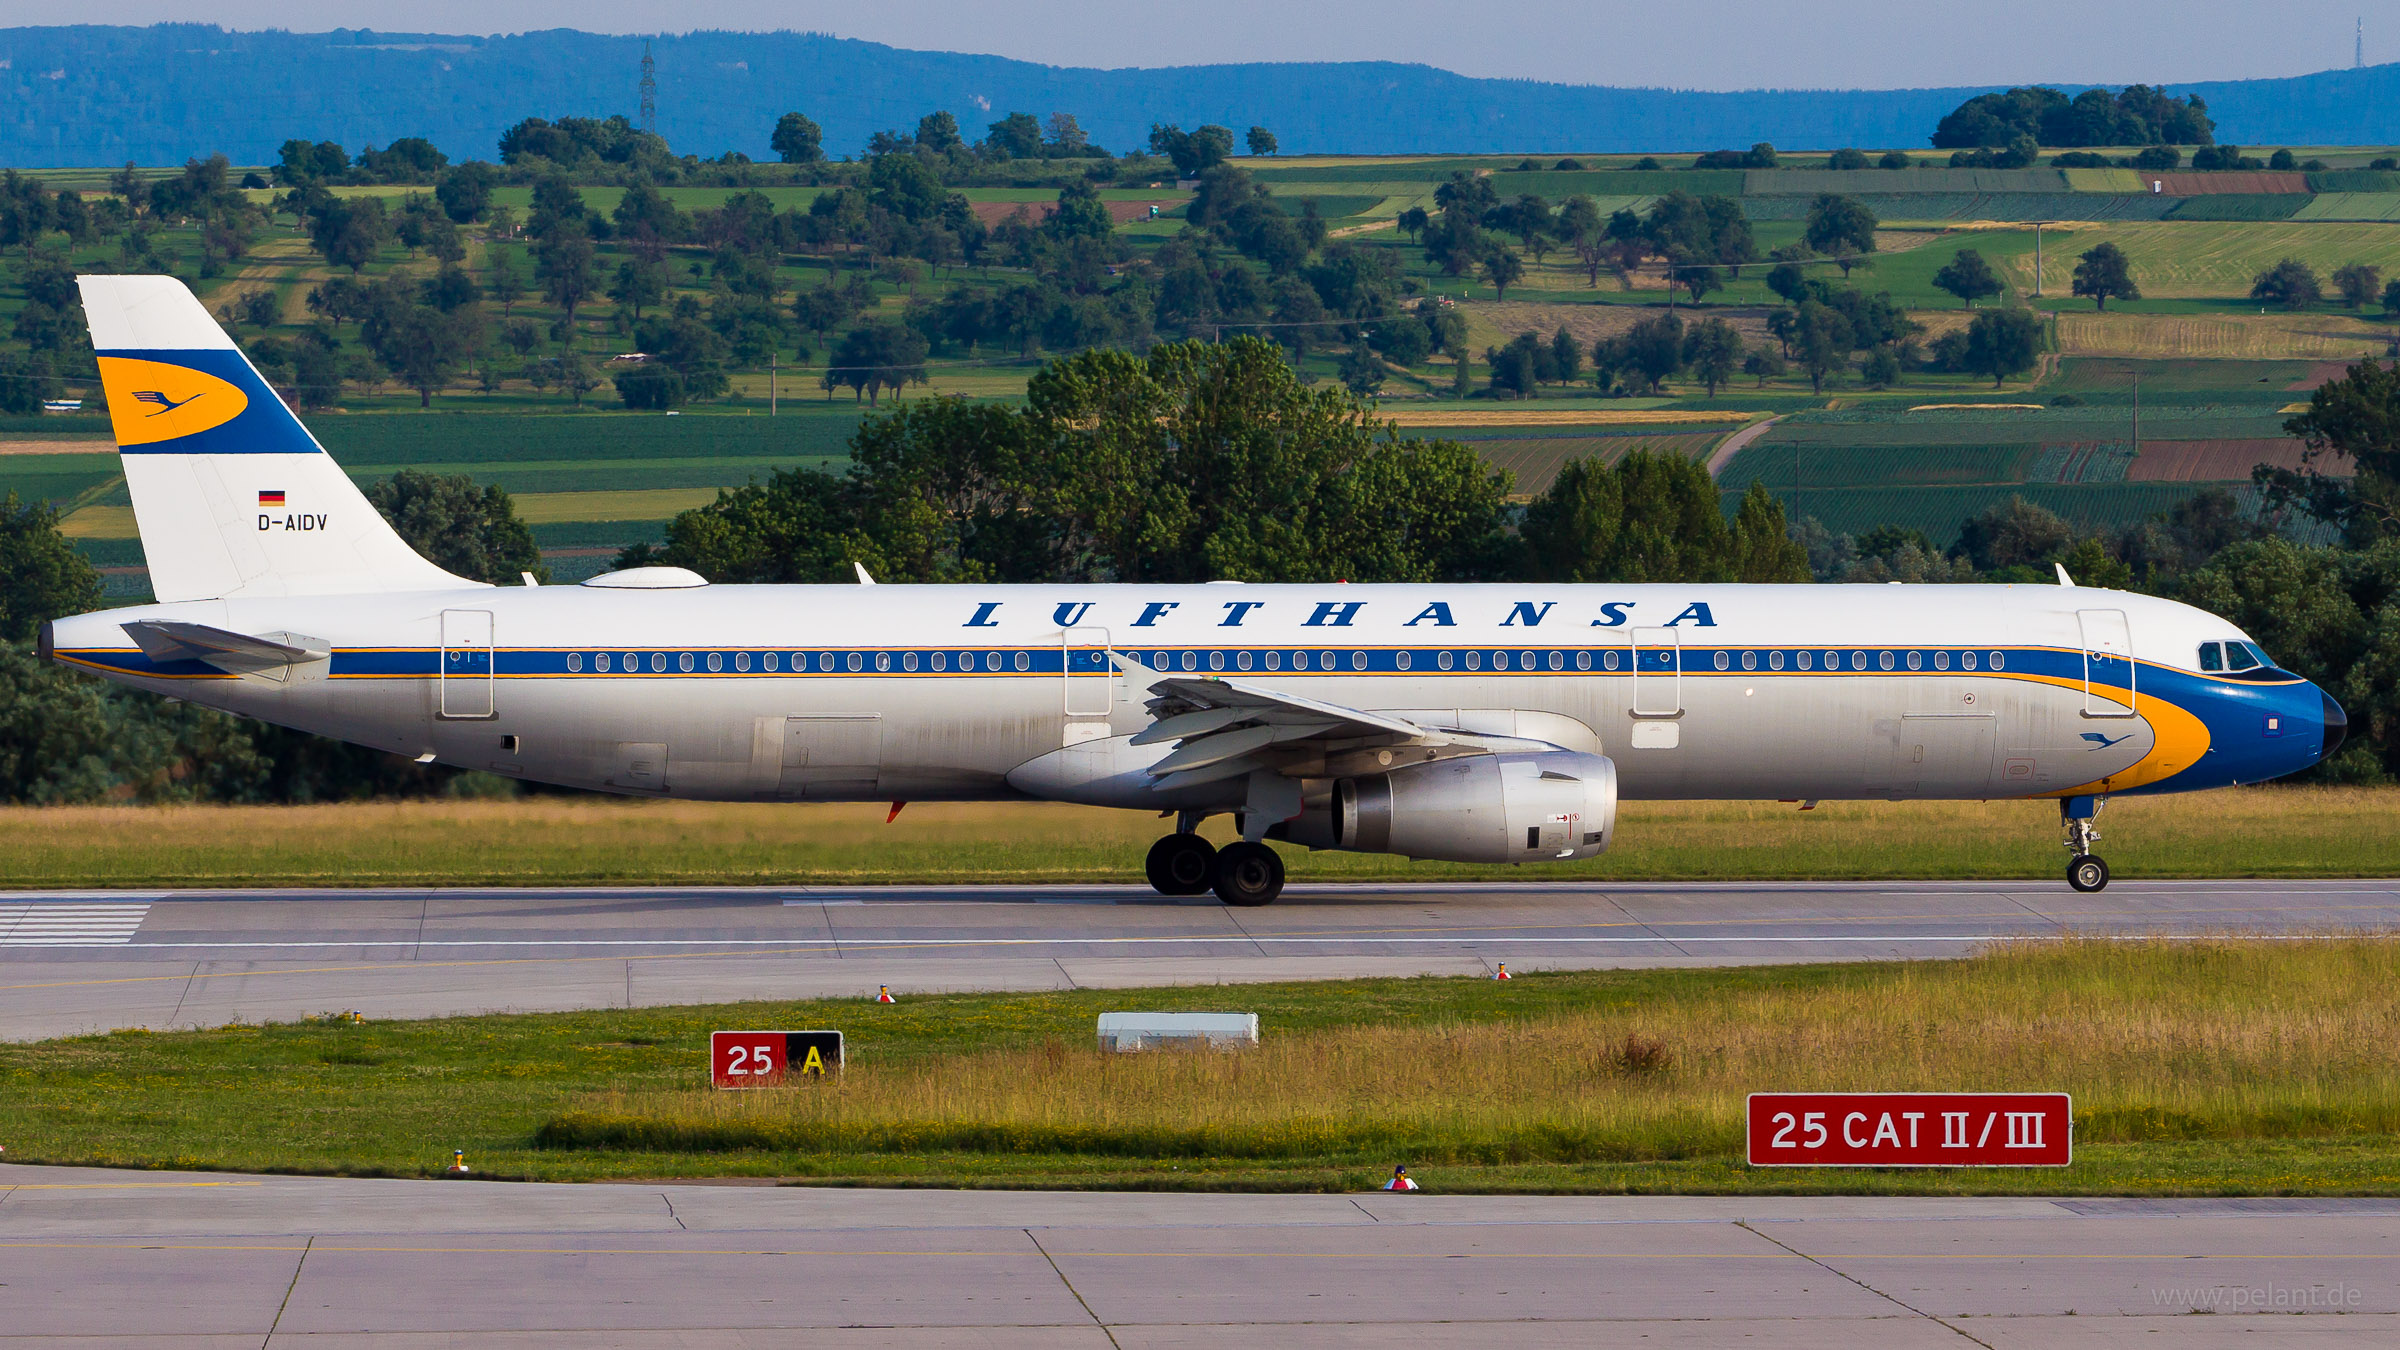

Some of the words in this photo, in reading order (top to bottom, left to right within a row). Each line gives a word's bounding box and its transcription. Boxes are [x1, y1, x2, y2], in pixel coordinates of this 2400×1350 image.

[258, 514, 328, 531] D-AIDV
[962, 602, 1718, 627] LUFTHANSA
[727, 1045, 773, 1075] 25
[802, 1045, 826, 1075] A
[1771, 1112, 1828, 1149] 25
[1843, 1112, 1925, 1149] CAT
[1941, 1112, 2047, 1149] II/III
